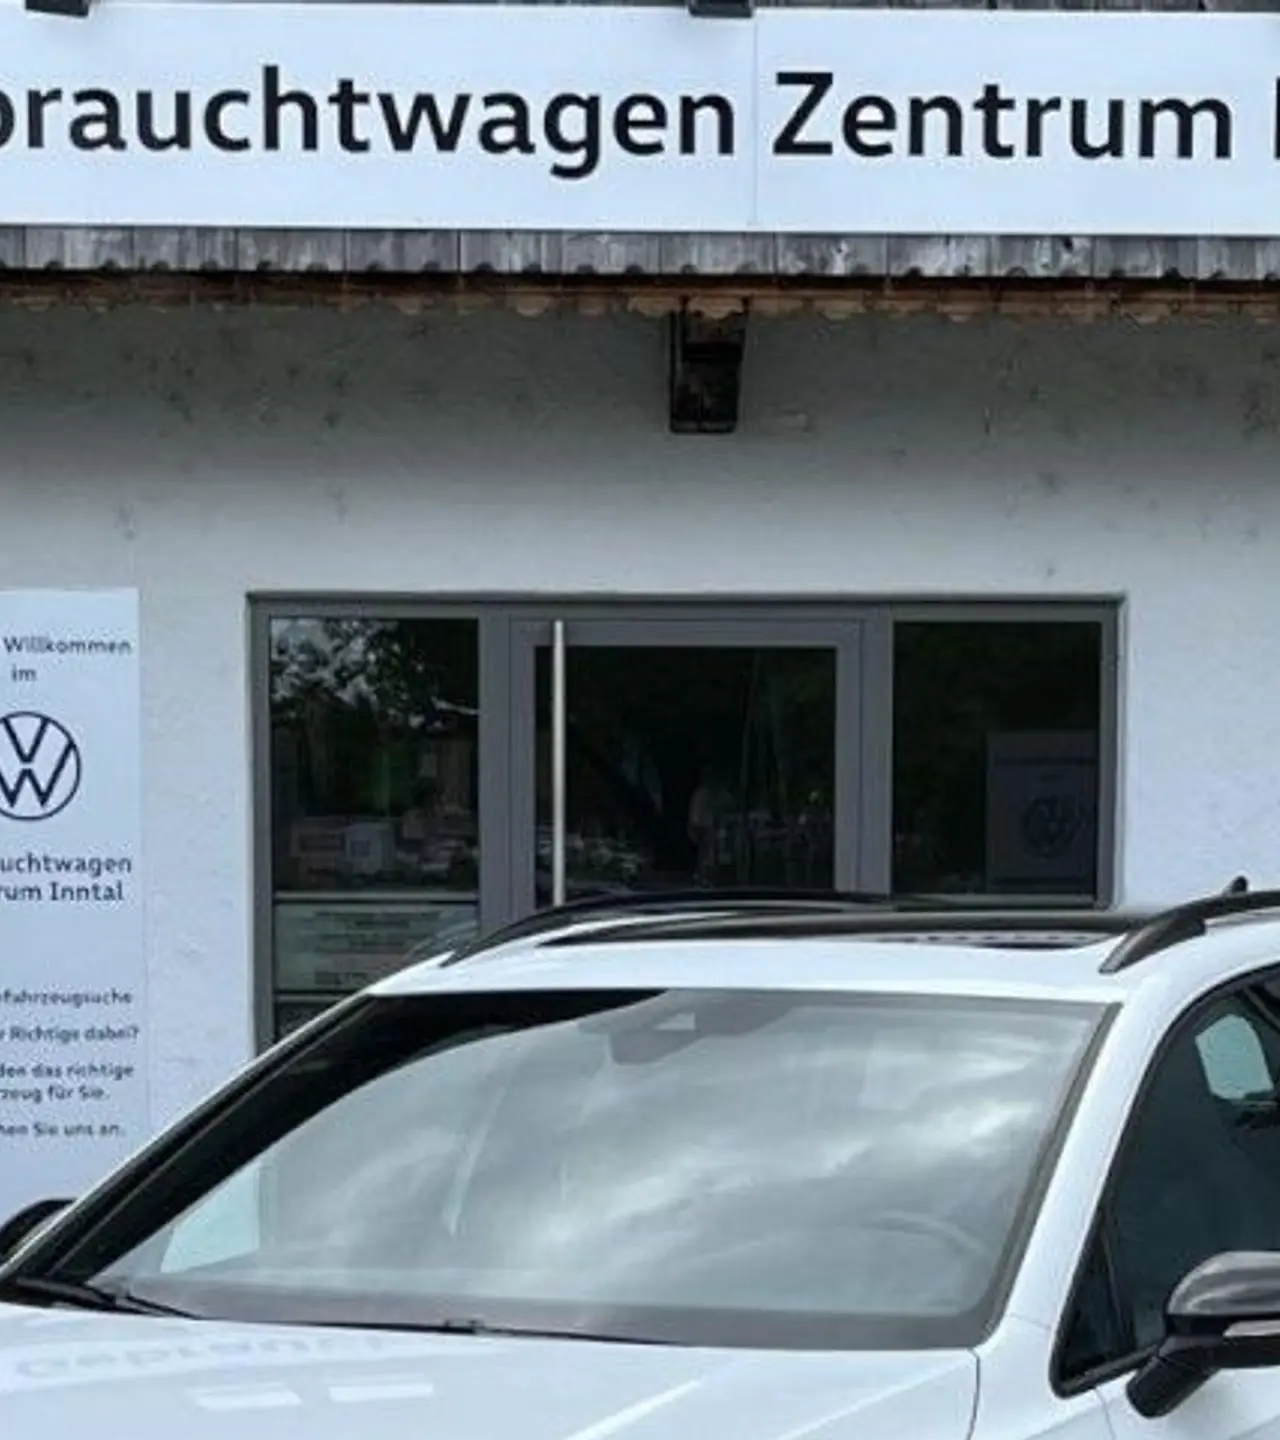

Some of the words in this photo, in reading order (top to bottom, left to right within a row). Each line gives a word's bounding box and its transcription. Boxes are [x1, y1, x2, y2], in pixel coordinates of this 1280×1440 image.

[772, 70, 1233, 161] Zentrum
[3, 635, 132, 654] Willkommen
[10, 664, 38, 683] im
[50, 879, 124, 902] Inntal
[9, 1025, 81, 1045] Richtige
[84, 1025, 140, 1041] dabei?
[31, 1062, 62, 1078] das
[67, 1063, 135, 1081] richtige
[47, 1084, 74, 1100] für
[32, 1121, 58, 1137] Sie
[63, 1123, 94, 1137] uns
